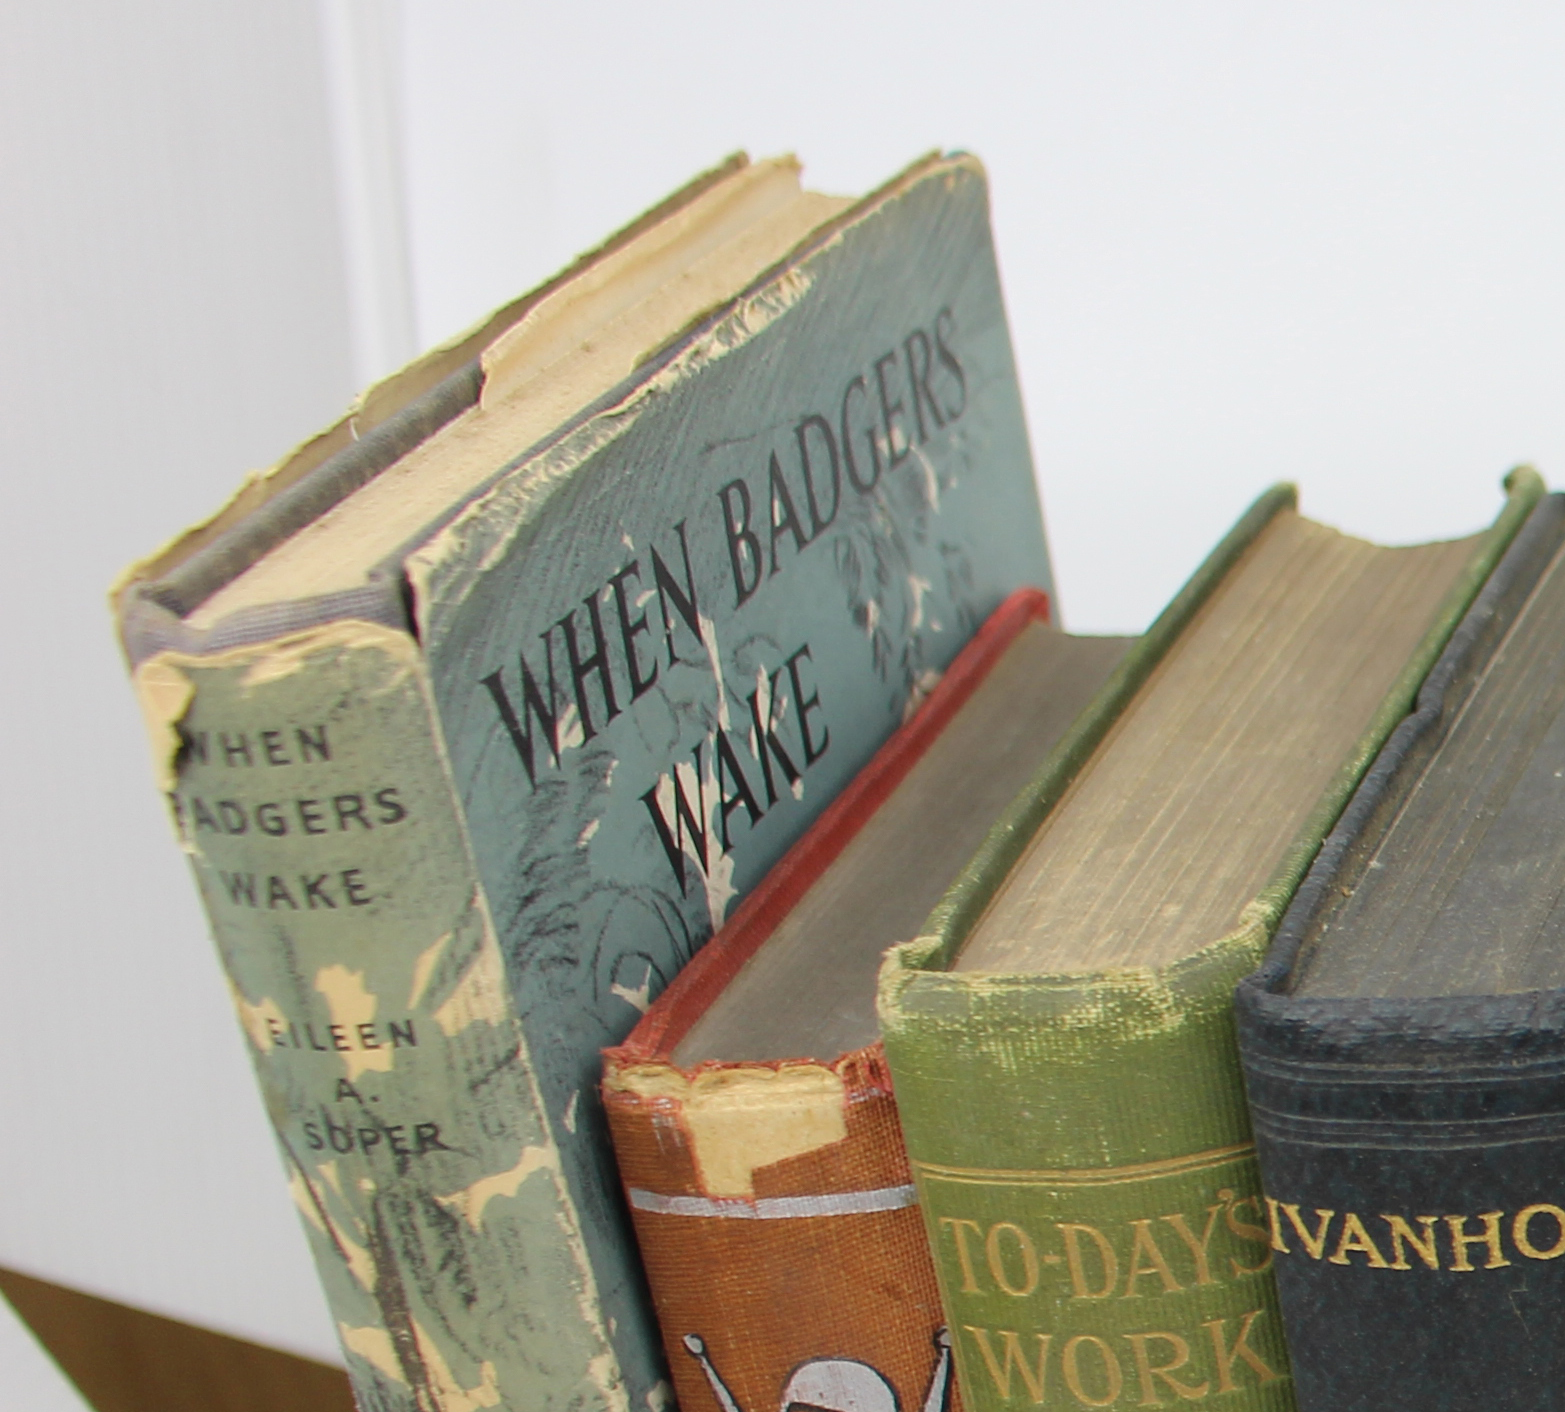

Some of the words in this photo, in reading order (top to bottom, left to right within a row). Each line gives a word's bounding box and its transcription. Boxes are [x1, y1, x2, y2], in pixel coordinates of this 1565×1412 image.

[479, 517, 706, 790] WHEN
[716, 307, 968, 610] BADGERS
[638, 643, 831, 900] WAKE
[218, 869, 372, 910] WAKE
[267, 1018, 418, 1051] EILEEN
[336, 1078, 380, 1104] A.
[939, 1189, 1273, 1301] TO-DAY'S
[965, 1311, 1293, 1408] WORK
